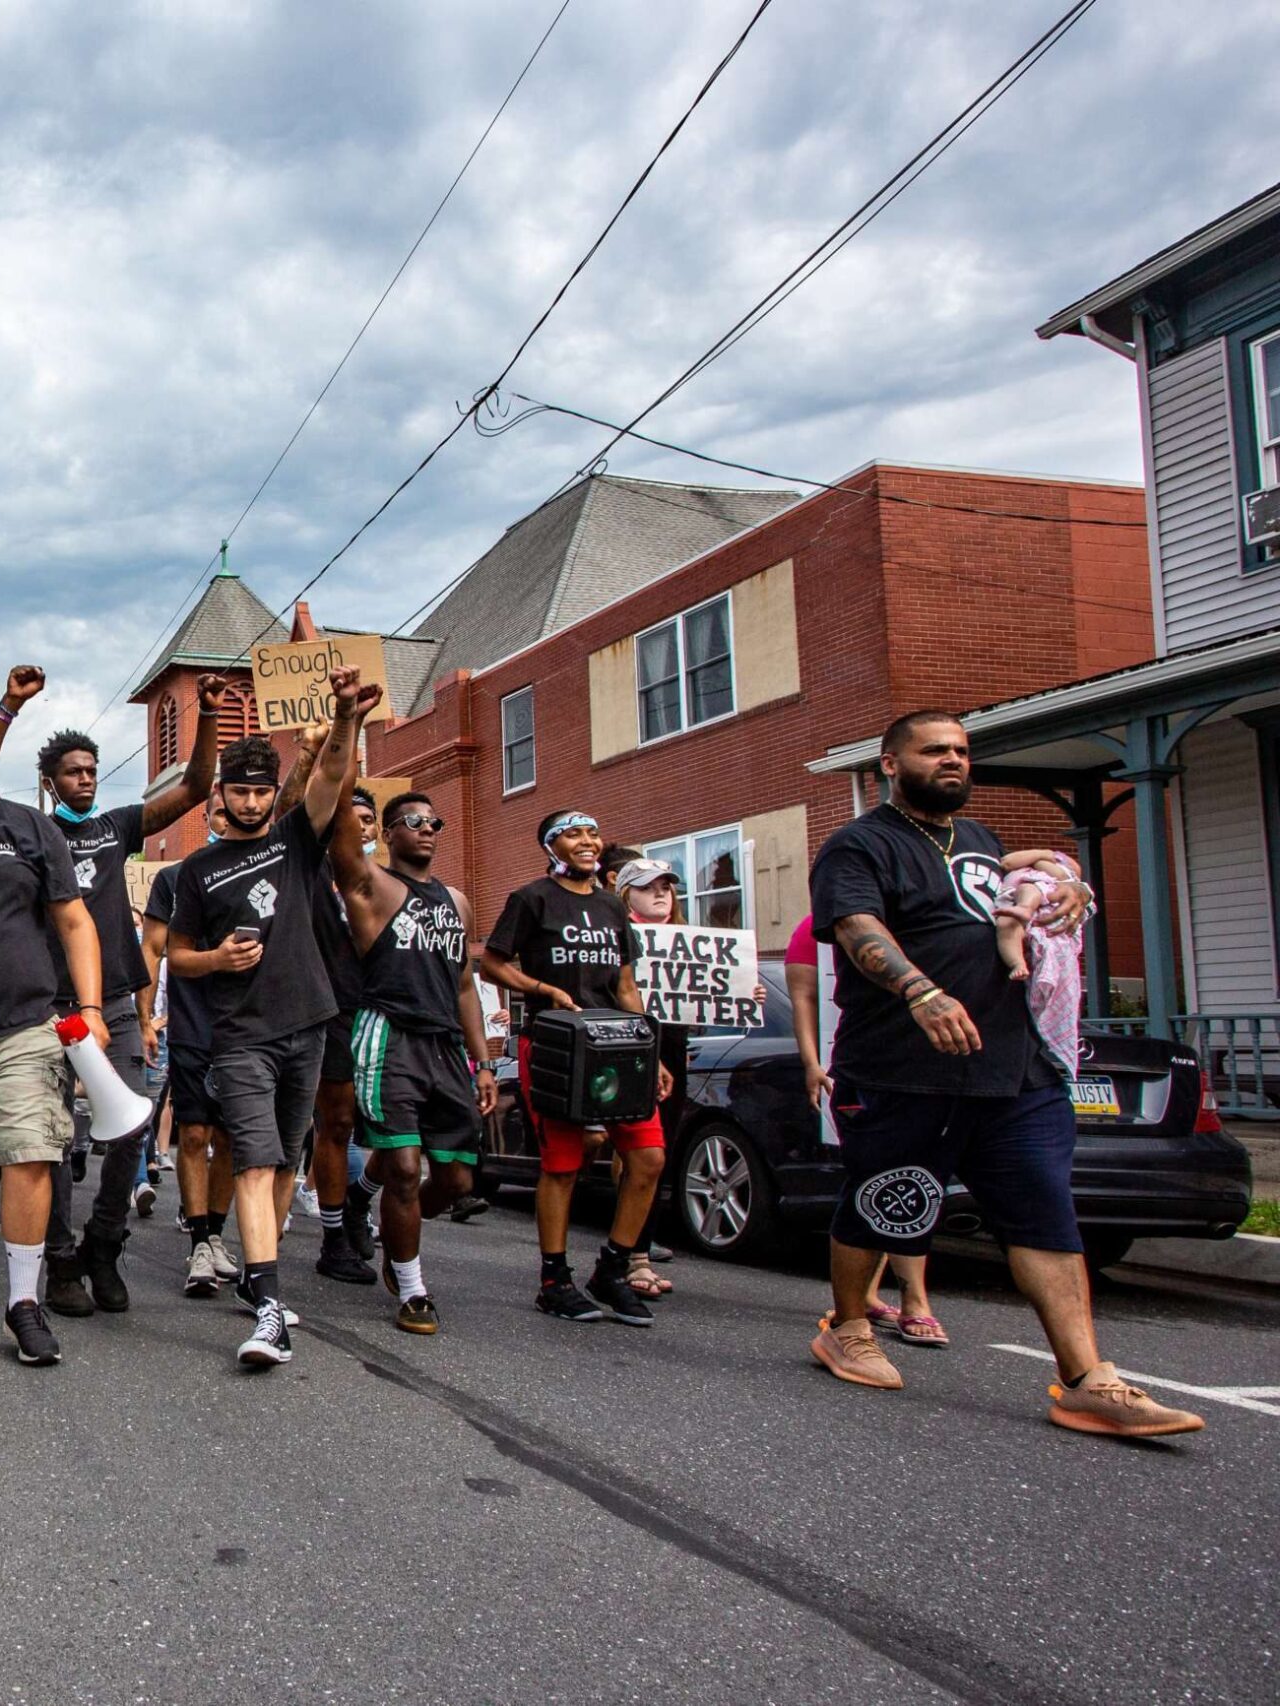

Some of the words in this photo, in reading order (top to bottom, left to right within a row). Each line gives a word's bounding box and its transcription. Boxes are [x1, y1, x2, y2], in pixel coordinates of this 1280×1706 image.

[258, 640, 343, 683] Enough
[265, 693, 337, 727] ENOUG
[204, 876, 212, 885] IF
[212, 868, 233, 880] NOT
[246, 849, 271, 864] THEN
[583, 911, 591, 928] I
[562, 925, 617, 946] Can't
[634, 960, 730, 995] LIVES
[640, 990, 761, 1026] ATTER
[1072, 1085, 1111, 1103] LUSIV
[865, 1171, 908, 1196] MORALS
[911, 1171, 938, 1197] OVER
[874, 1216, 922, 1233] MONEY
